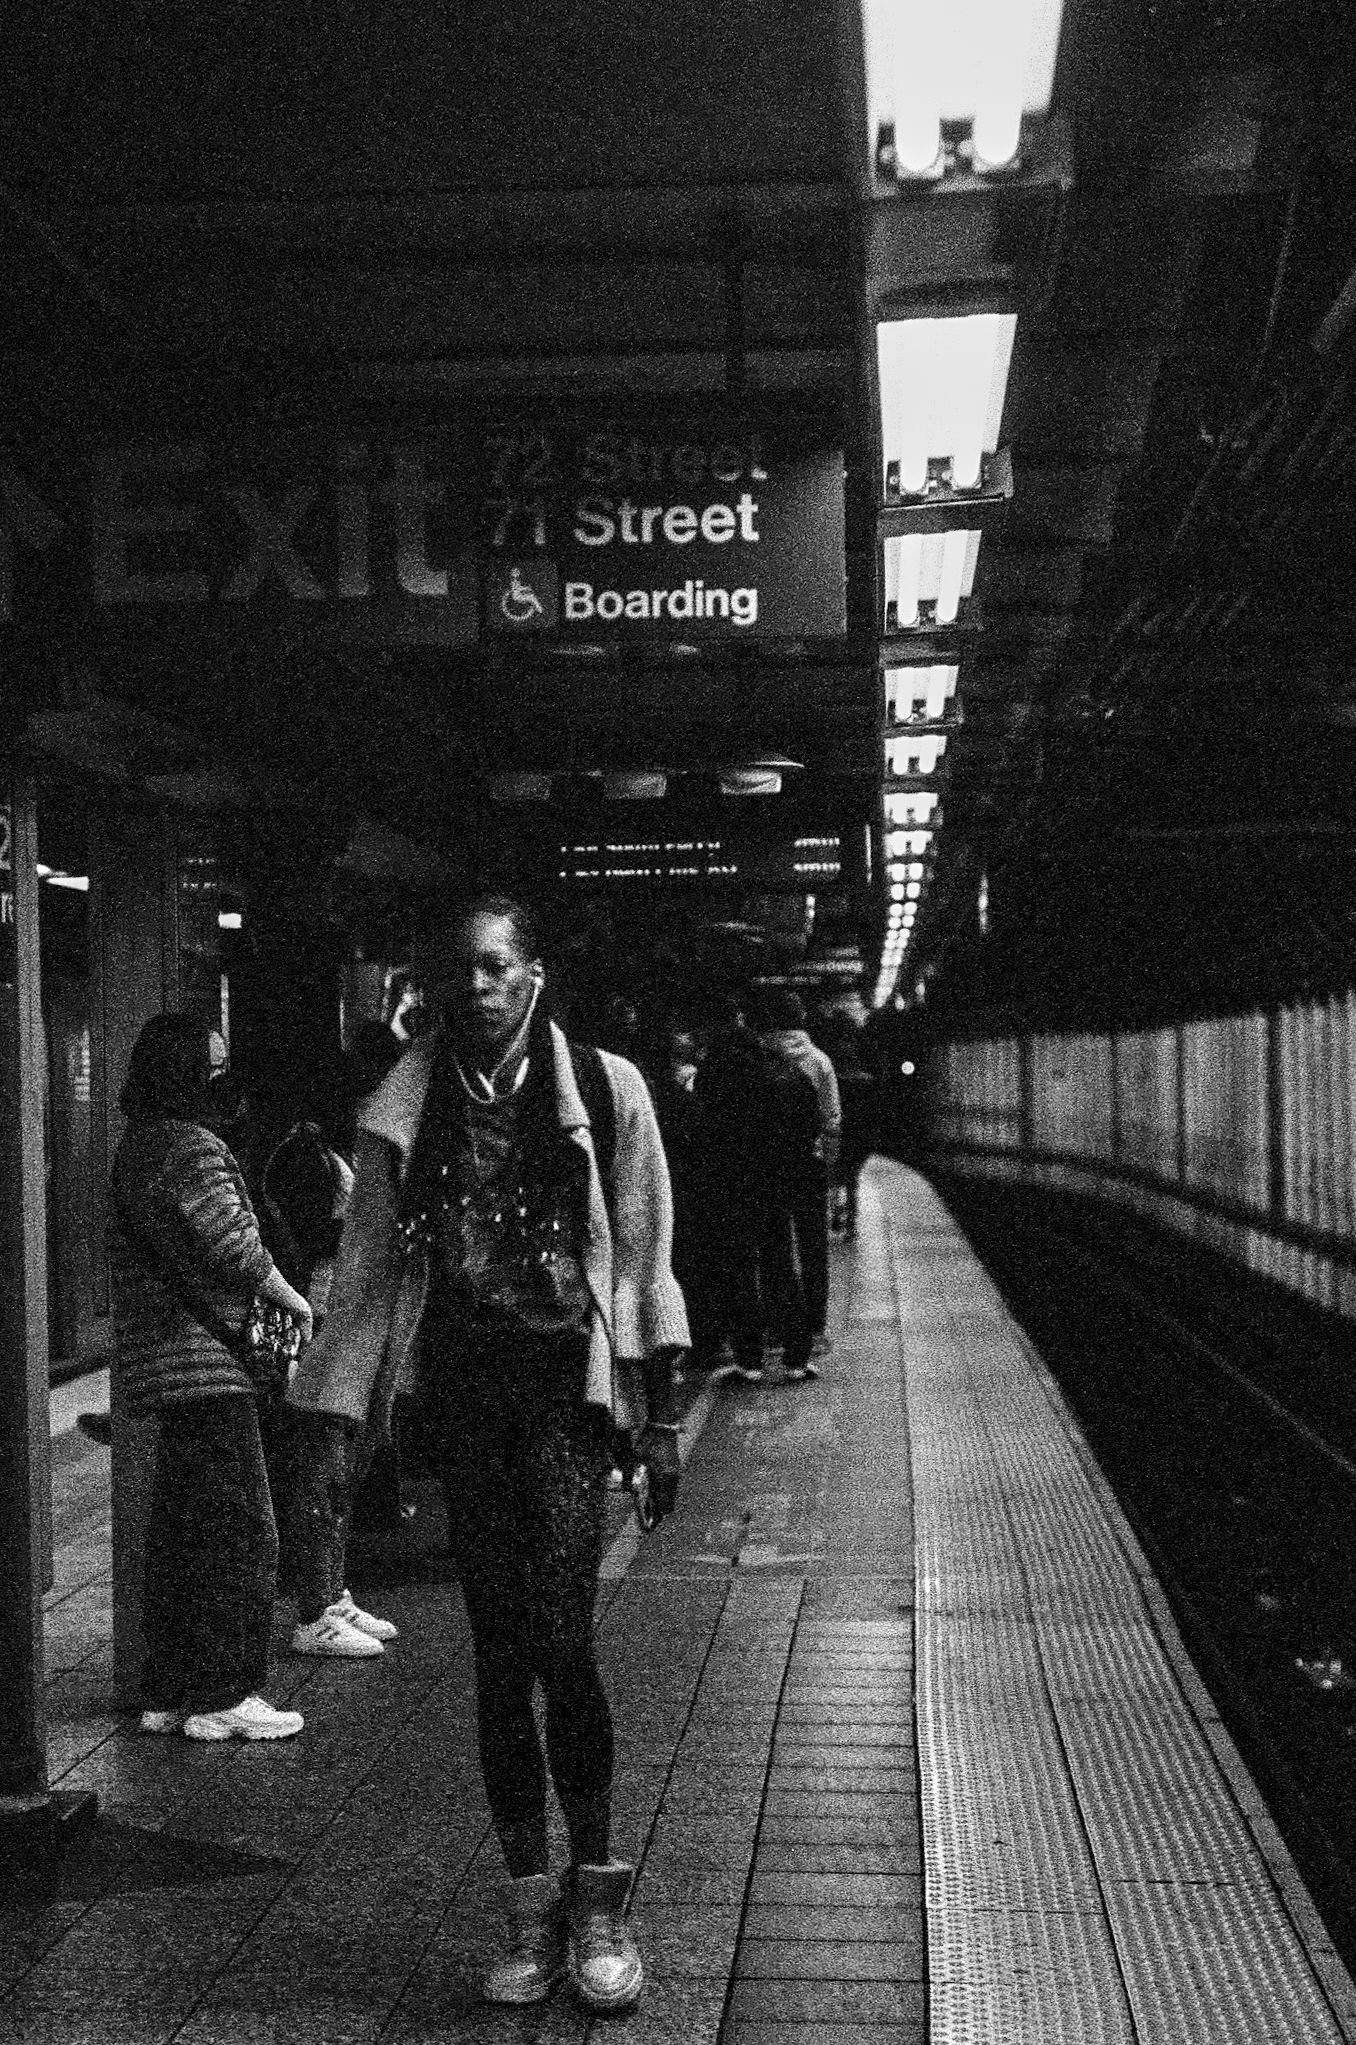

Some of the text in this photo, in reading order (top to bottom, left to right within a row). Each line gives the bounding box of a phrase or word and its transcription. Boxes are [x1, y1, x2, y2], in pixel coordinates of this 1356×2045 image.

[582, 434, 768, 483] Street
[91, 440, 449, 601] Exit
[573, 493, 760, 546] Street
[564, 579, 759, 626] Boarding
